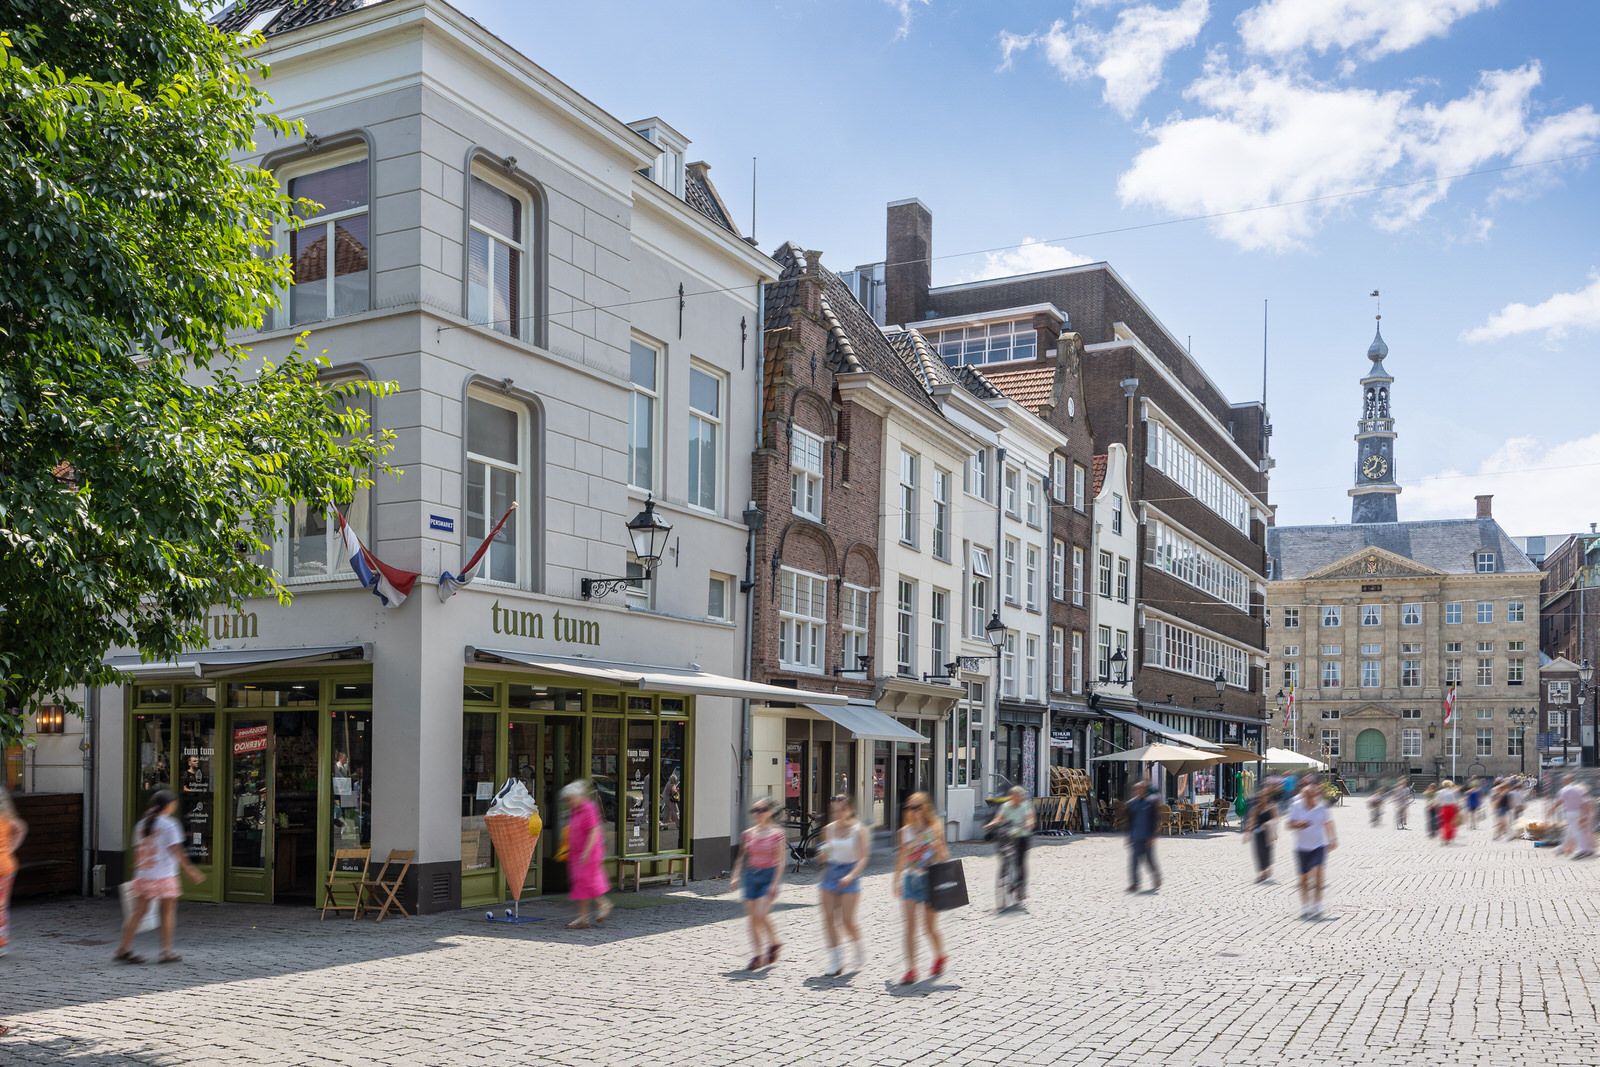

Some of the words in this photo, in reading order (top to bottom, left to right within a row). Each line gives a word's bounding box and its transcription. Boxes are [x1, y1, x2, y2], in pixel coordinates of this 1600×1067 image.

[430, 518, 453, 528] PENSMARKT
[203, 609, 259, 640] tum
[491, 599, 544, 639] tum
[553, 608, 600, 646] tum
[183, 746, 198, 755] tum
[200, 746, 215, 755] tum
